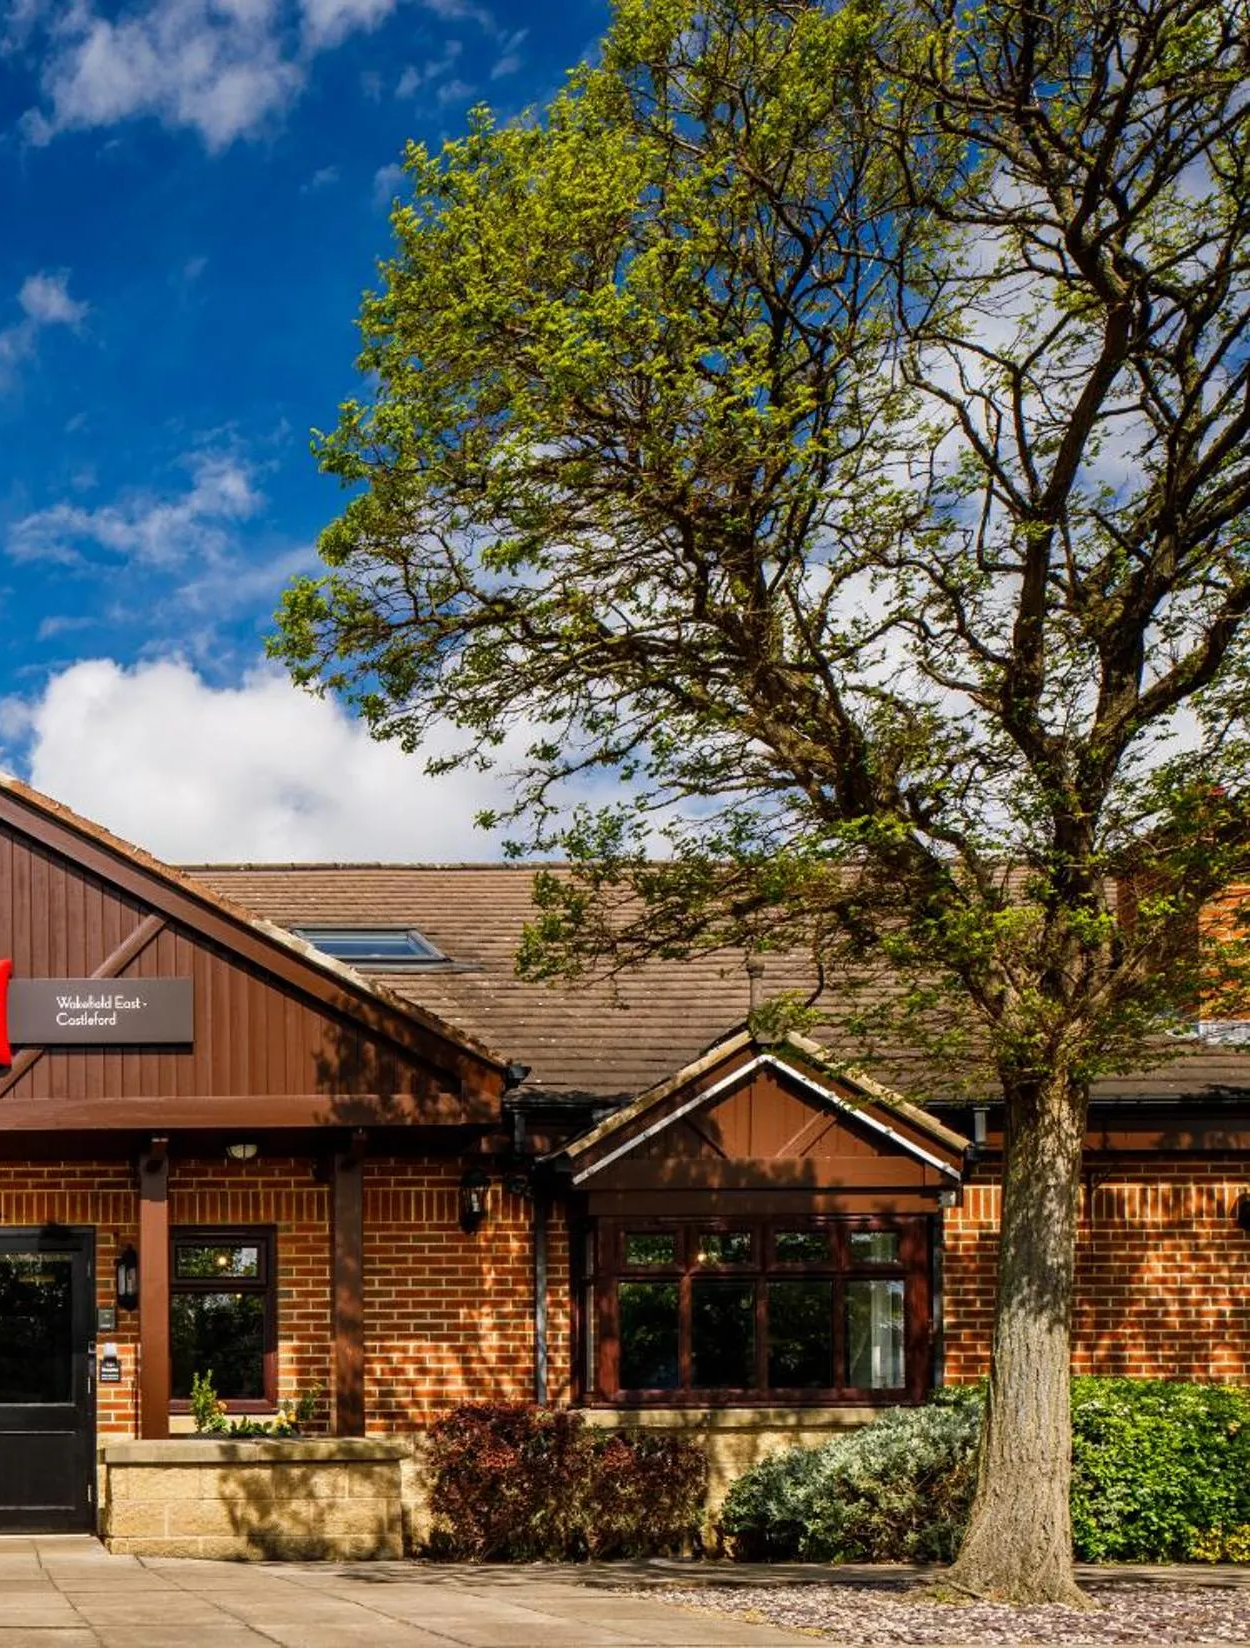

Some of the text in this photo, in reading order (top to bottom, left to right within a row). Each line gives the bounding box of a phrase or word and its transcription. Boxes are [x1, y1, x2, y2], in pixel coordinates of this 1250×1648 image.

[56, 994, 112, 1009] Wakefield
[114, 995, 141, 1009] East
[56, 1011, 116, 1026] Castleford
